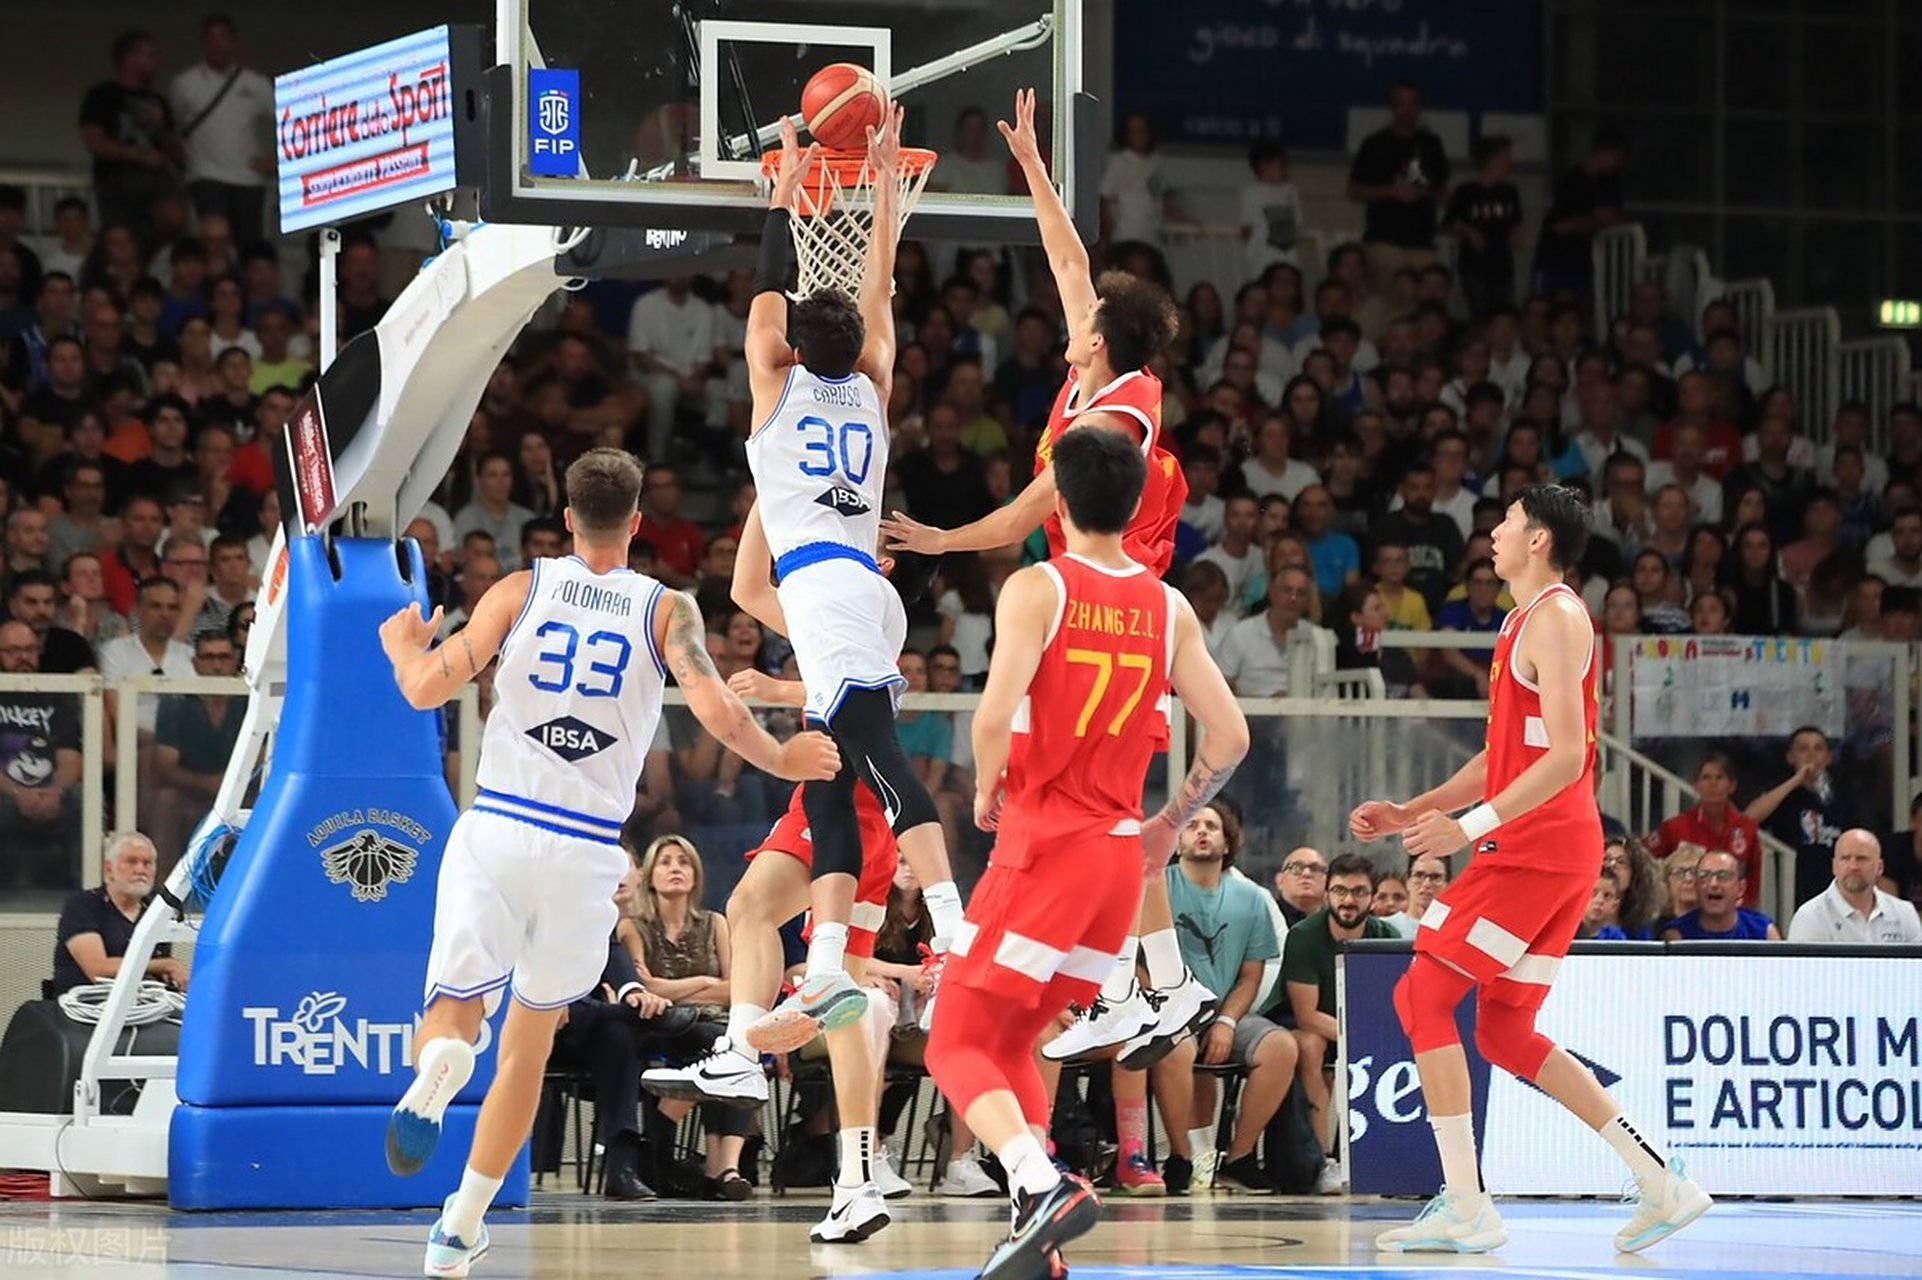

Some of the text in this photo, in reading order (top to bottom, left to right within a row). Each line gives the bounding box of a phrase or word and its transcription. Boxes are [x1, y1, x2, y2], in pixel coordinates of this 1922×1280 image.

[1293, 16, 1323, 50] di
[281, 94, 360, 160] Corriere
[388, 61, 447, 147] Sport
[535, 139, 574, 154] FIP
[812, 385, 862, 408] CARUSO
[797, 416, 873, 485] 30
[551, 579, 632, 617] POLONARA
[1066, 599, 1125, 636] ZHANG
[528, 619, 632, 698] 33
[1065, 648, 1153, 738] 77
[541, 725, 600, 751] IBSA
[306, 807, 433, 848] AQUILA BASKET
[1664, 1014, 1918, 1067] DOLORI M
[1666, 1079, 1694, 1129] E
